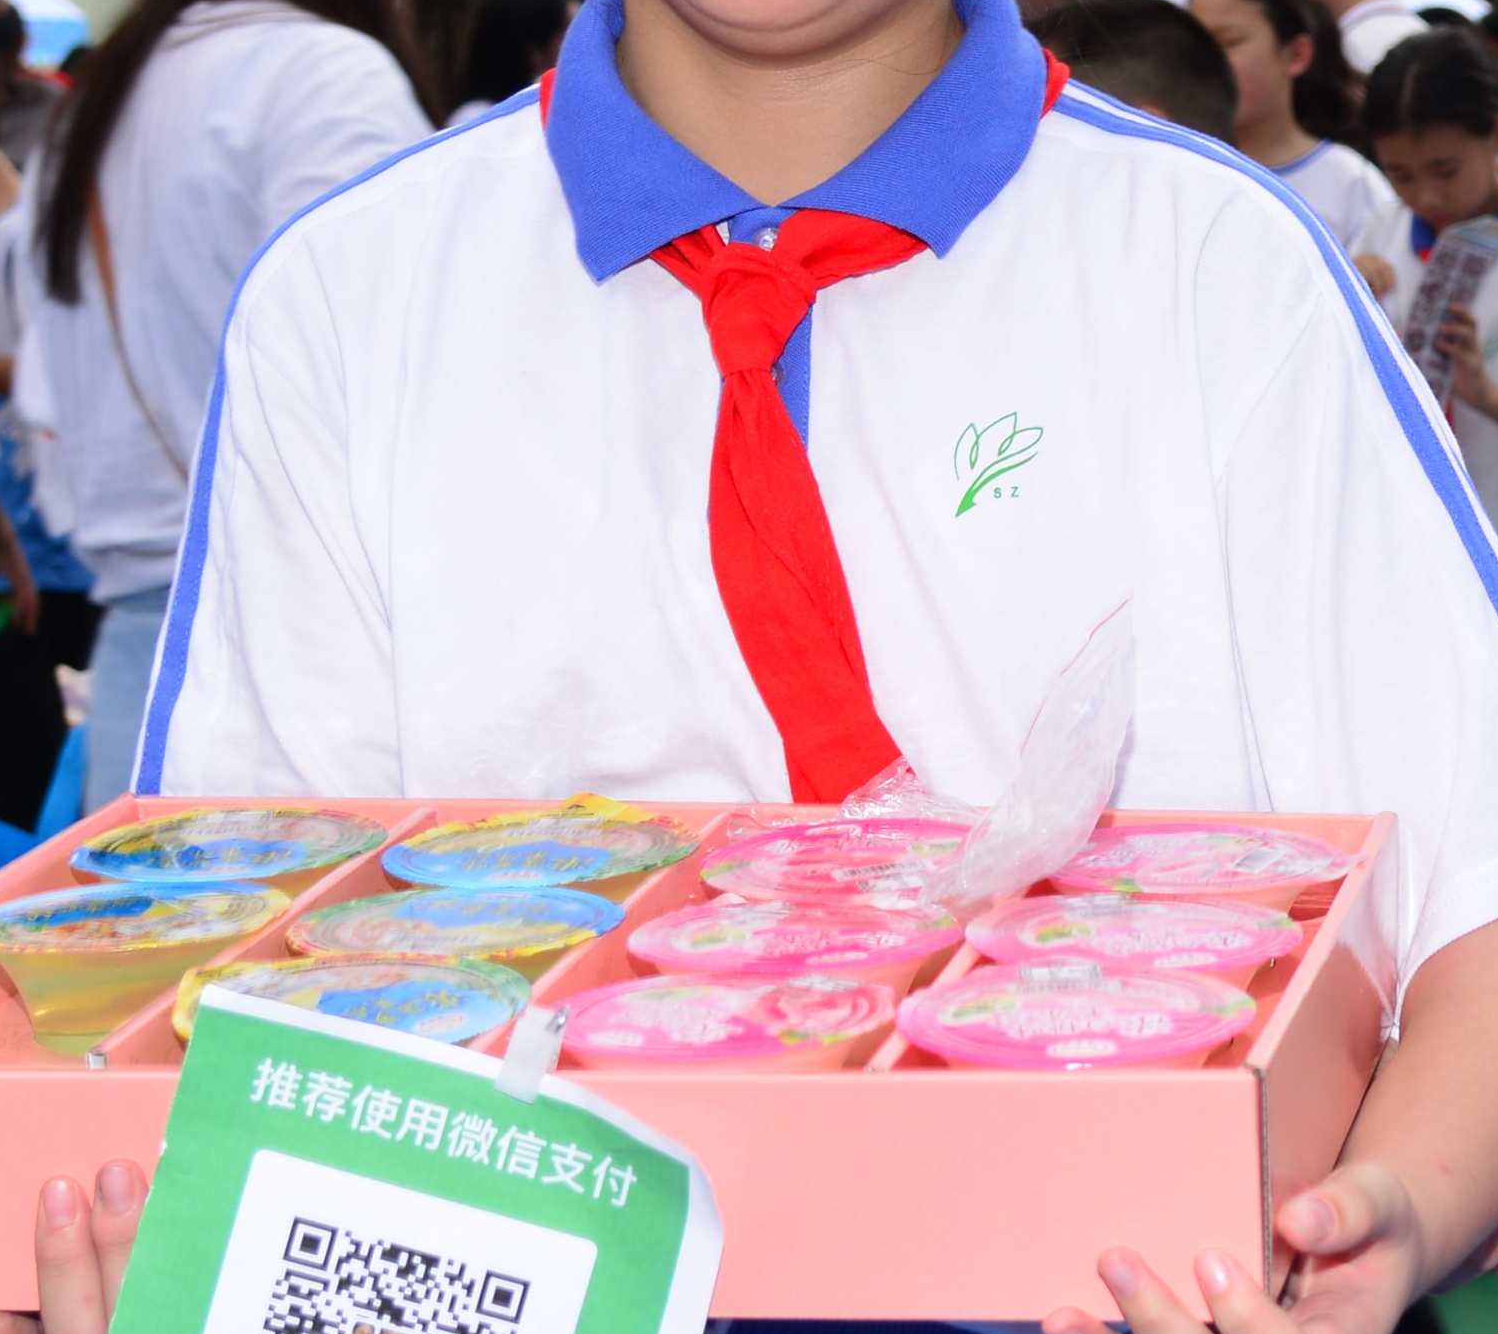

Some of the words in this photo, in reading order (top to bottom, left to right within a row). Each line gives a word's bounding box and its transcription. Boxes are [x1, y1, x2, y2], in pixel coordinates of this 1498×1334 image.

[249, 1056, 639, 1209] 推荐使用微信支付
